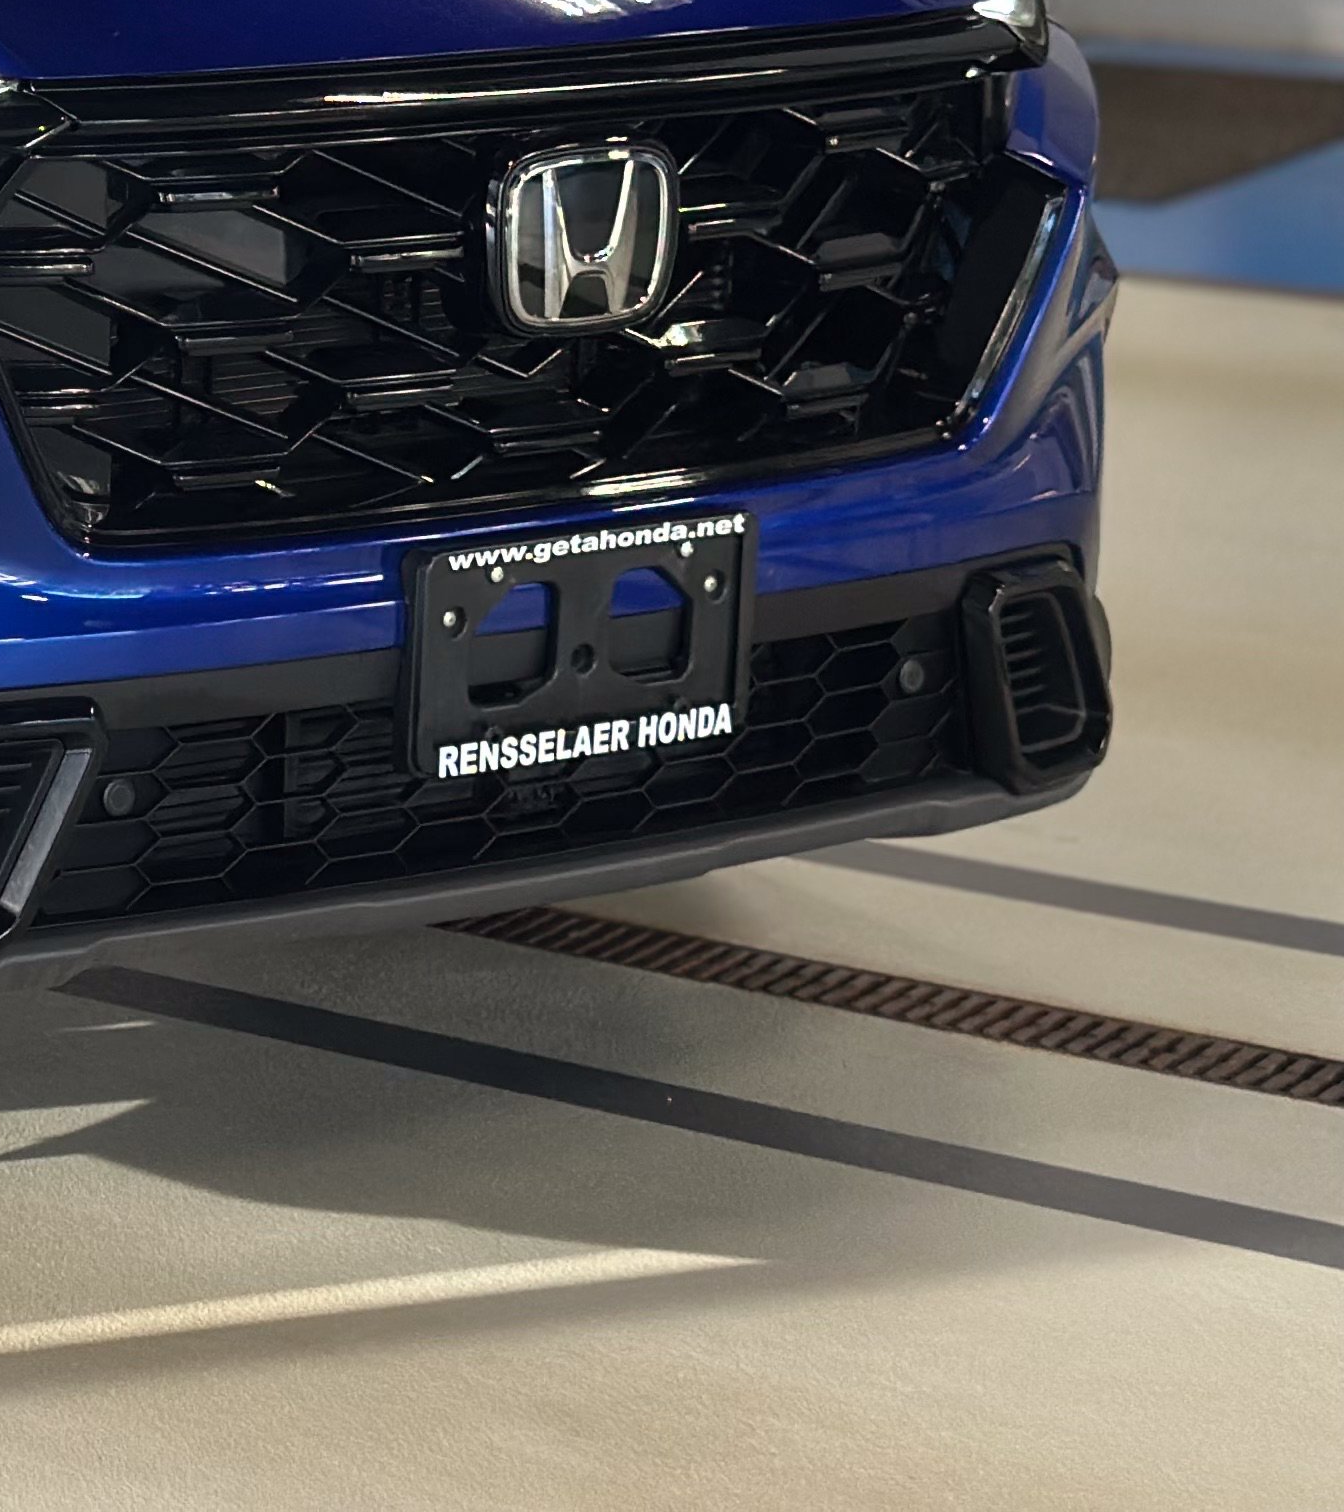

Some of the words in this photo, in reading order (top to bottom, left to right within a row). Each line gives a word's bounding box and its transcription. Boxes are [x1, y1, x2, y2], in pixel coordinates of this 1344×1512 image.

[448, 513, 746, 571] www.getahonda.net
[439, 719, 630, 779] RENSSELAER
[637, 703, 733, 749] HONDA
